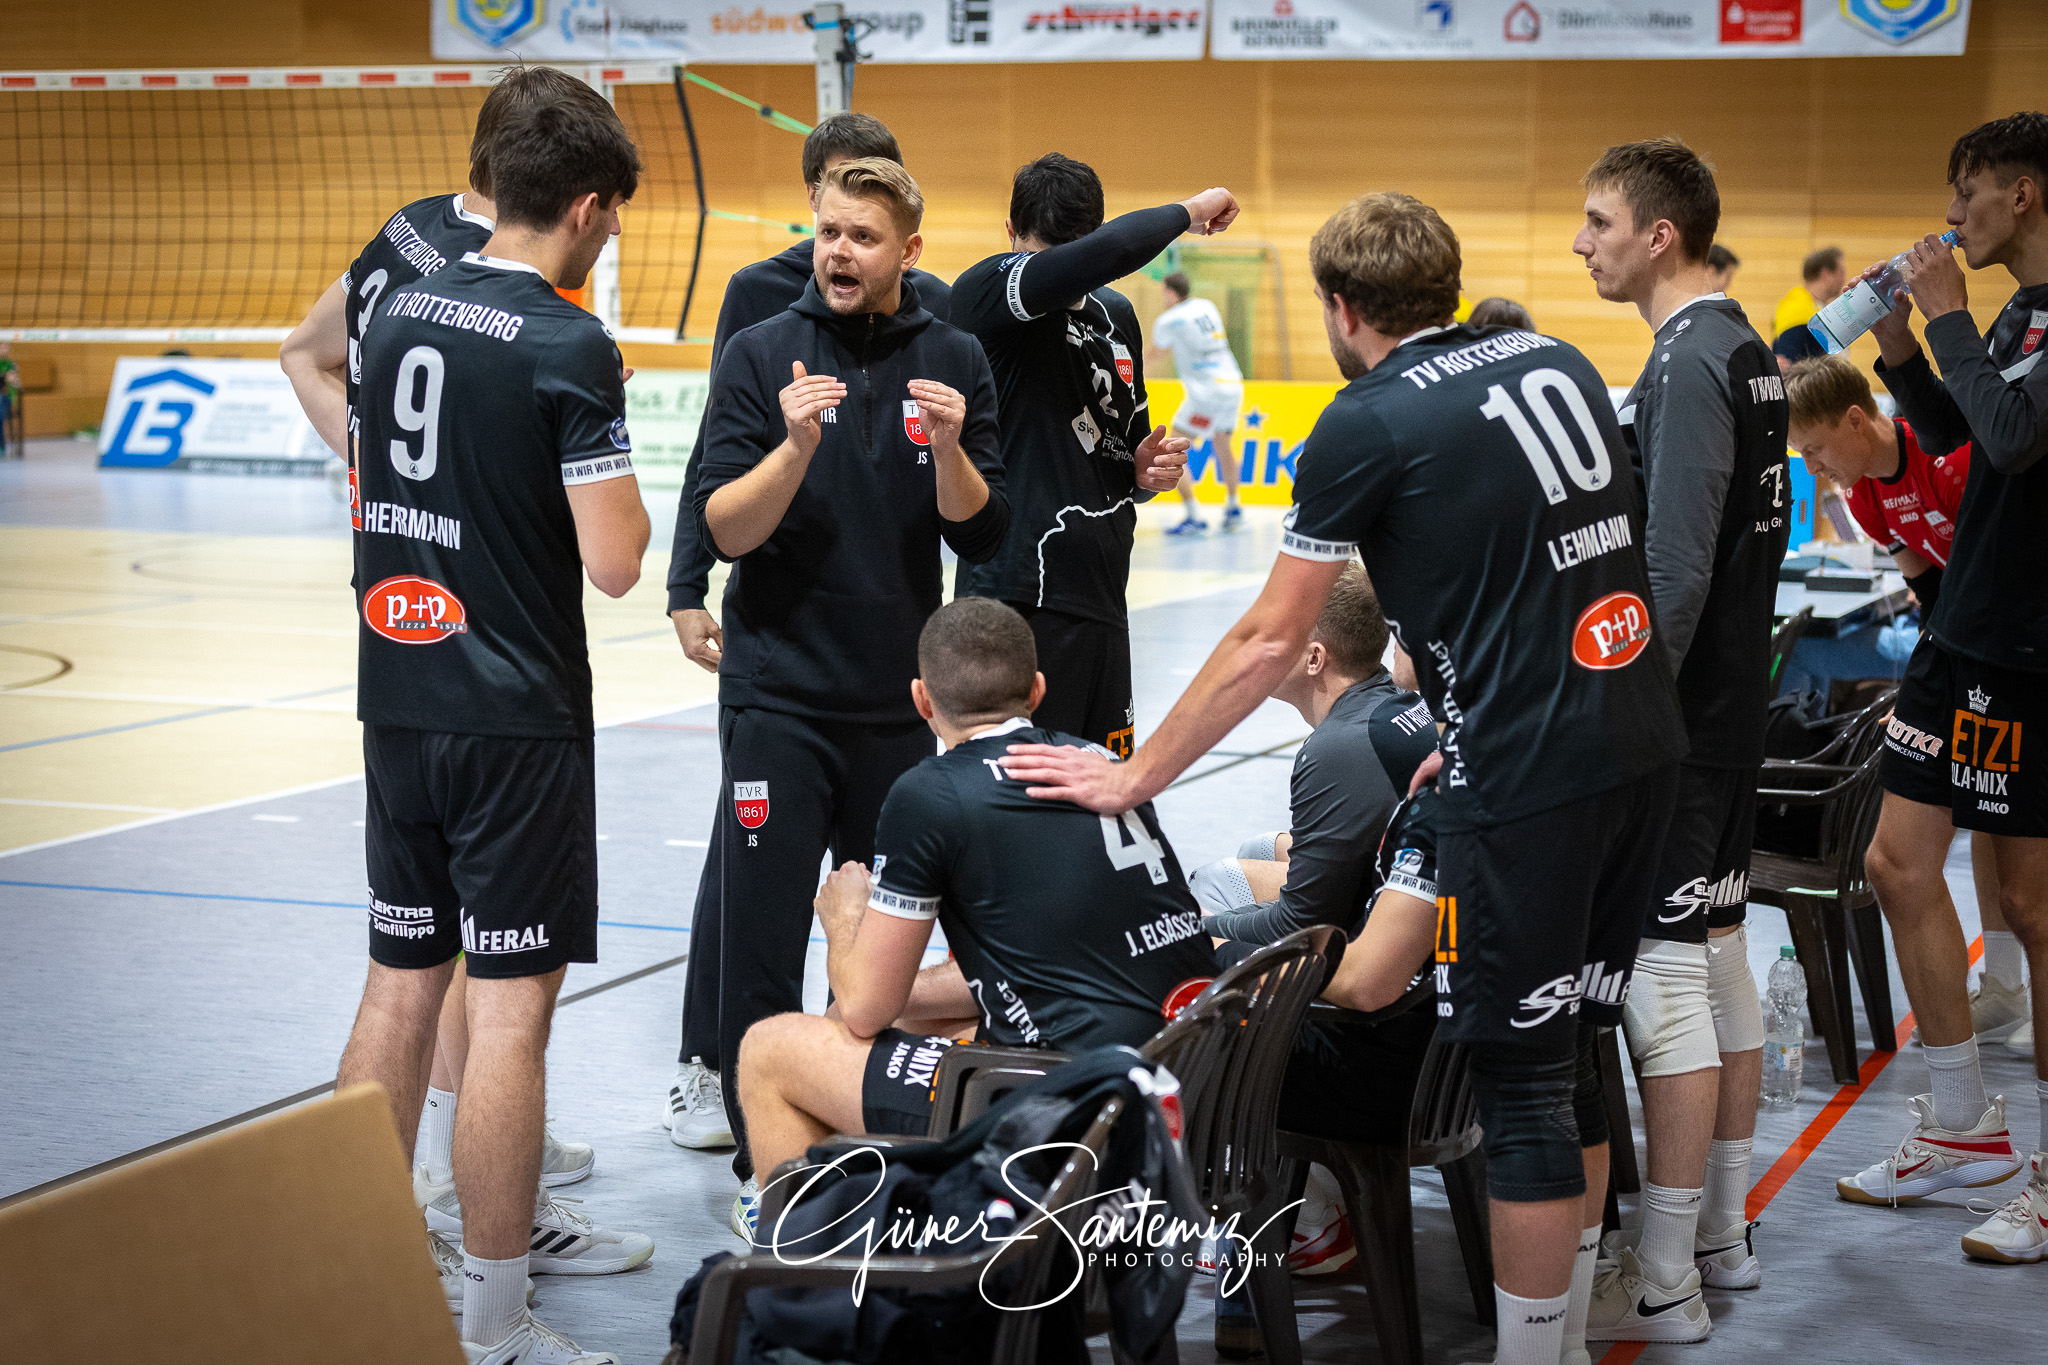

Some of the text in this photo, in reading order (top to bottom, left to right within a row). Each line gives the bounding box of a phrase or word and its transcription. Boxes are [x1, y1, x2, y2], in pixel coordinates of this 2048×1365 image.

[1010, 269, 1020, 284] WIR
[387, 292, 523, 342] TV ROTTENBURG
[1119, 365, 1132, 376] 1861
[1400, 331, 1557, 390] TV ROTTENBURG
[389, 346, 445, 480] 9
[1479, 368, 1612, 505] 10
[575, 464, 593, 477] WIR
[595, 460, 613, 473] WIR
[917, 452, 928, 465] JS
[1899, 512, 1919, 524] JAKO
[1547, 514, 1632, 571] LEHMANN
[1391, 713, 1417, 736] TV
[1952, 709, 2022, 772] ETZ!
[738, 786, 762, 798] TVR
[739, 806, 764, 818] 1861
[1977, 799, 2009, 814] JAKO
[747, 834, 758, 847] JS
[1100, 808, 1168, 885] 4
[1402, 876, 1418, 888] WIR
[1419, 881, 1437, 895] WIR
[899, 898, 917, 911] WIR
[373, 917, 435, 940] Sanfilippo
[479, 924, 549, 951] FERAL
[1125, 931, 1144, 957] J.
[886, 1042, 911, 1079] JAKO
